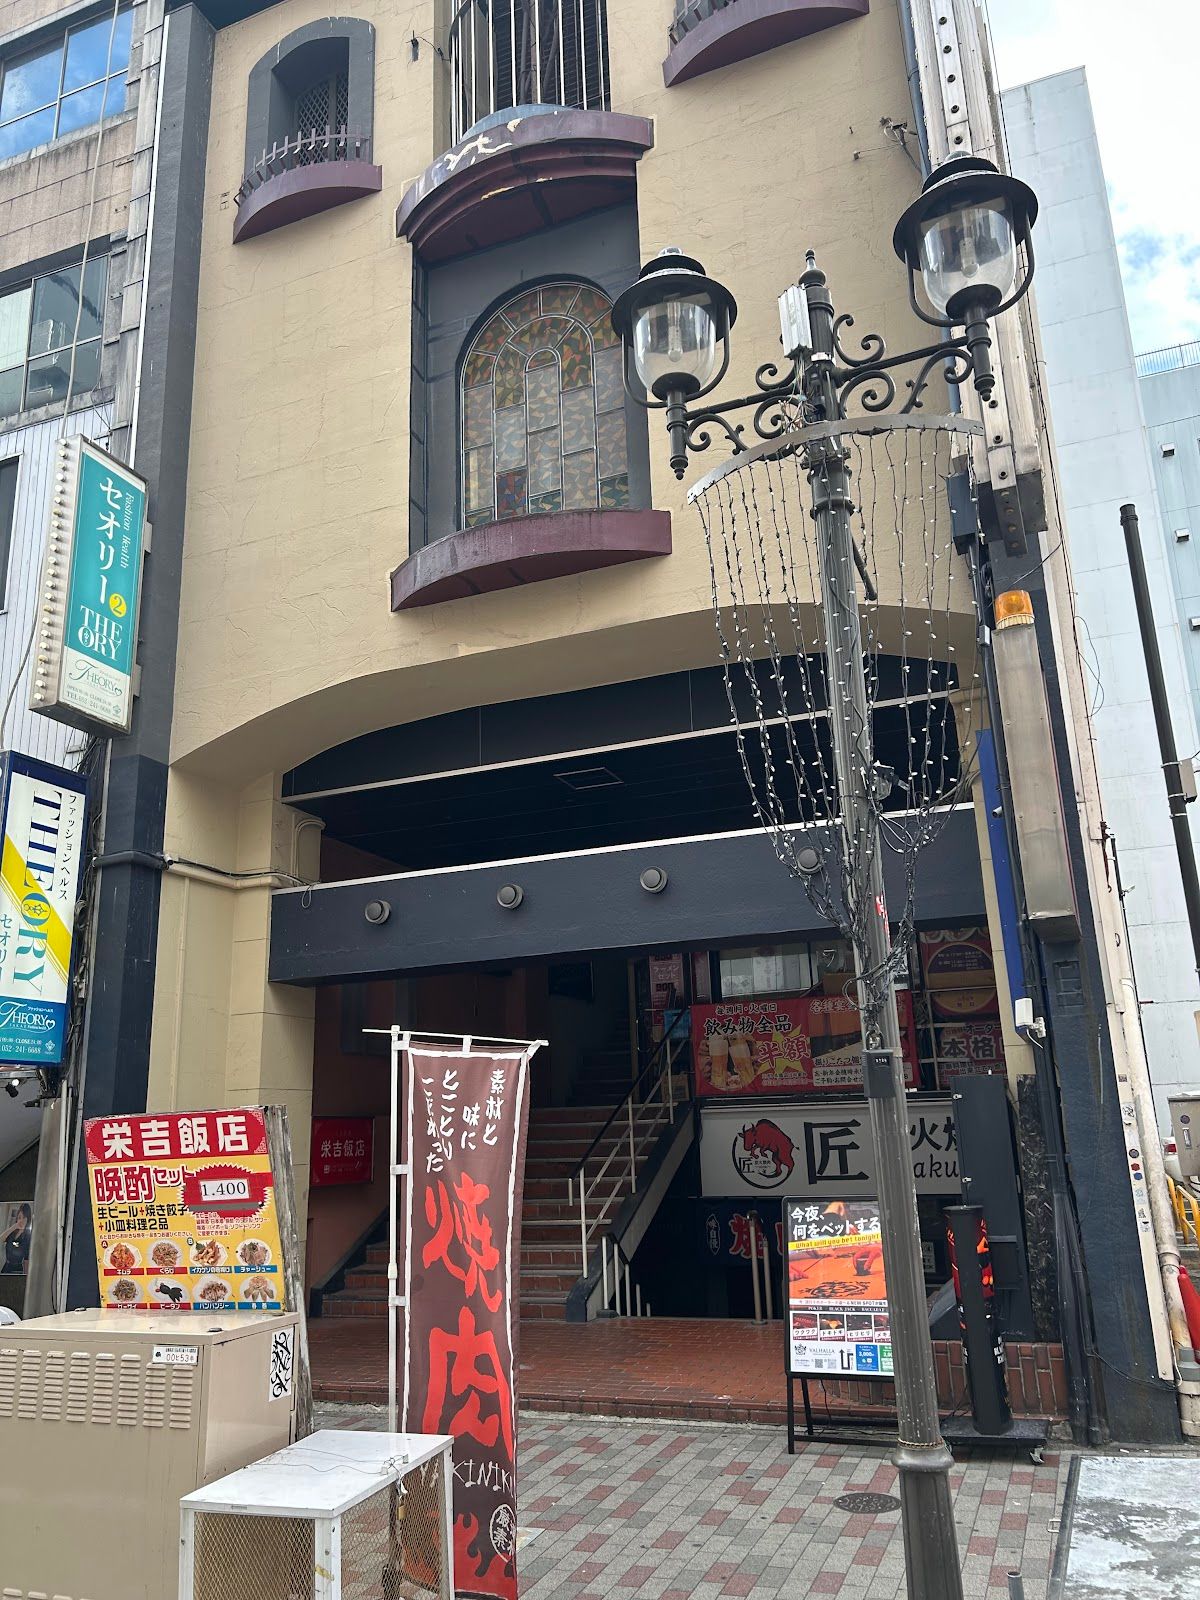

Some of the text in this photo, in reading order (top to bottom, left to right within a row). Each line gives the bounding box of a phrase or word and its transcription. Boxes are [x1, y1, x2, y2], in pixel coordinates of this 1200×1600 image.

[96, 476, 123, 605] セオリー
[120, 492, 136, 569] Fashion Health
[80, 605, 123, 641] THE
[112, 595, 124, 616] 2
[77, 626, 123, 661] ORY
[58, 793, 77, 900] ファッションヘルス
[13, 790, 62, 997] THEORY
[704, 1013, 792, 1036] 飲み物全品
[757, 1034, 810, 1069] 半額
[461, 1103, 481, 1150] 味に
[483, 1069, 505, 1146] 素材と
[101, 1114, 250, 1160] 栄吉飯店
[321, 1139, 365, 1158] 栄吉飯店
[804, 1119, 869, 1185] 匠
[94, 1164, 196, 1205] 晩酌セット
[914, 1153, 959, 1179] aku
[201, 1181, 247, 1198] 1.400
[790, 1205, 826, 1223] 今夜、
[792, 1217, 881, 1241] 何をベットする
[422, 1171, 513, 1463] 焼肉
